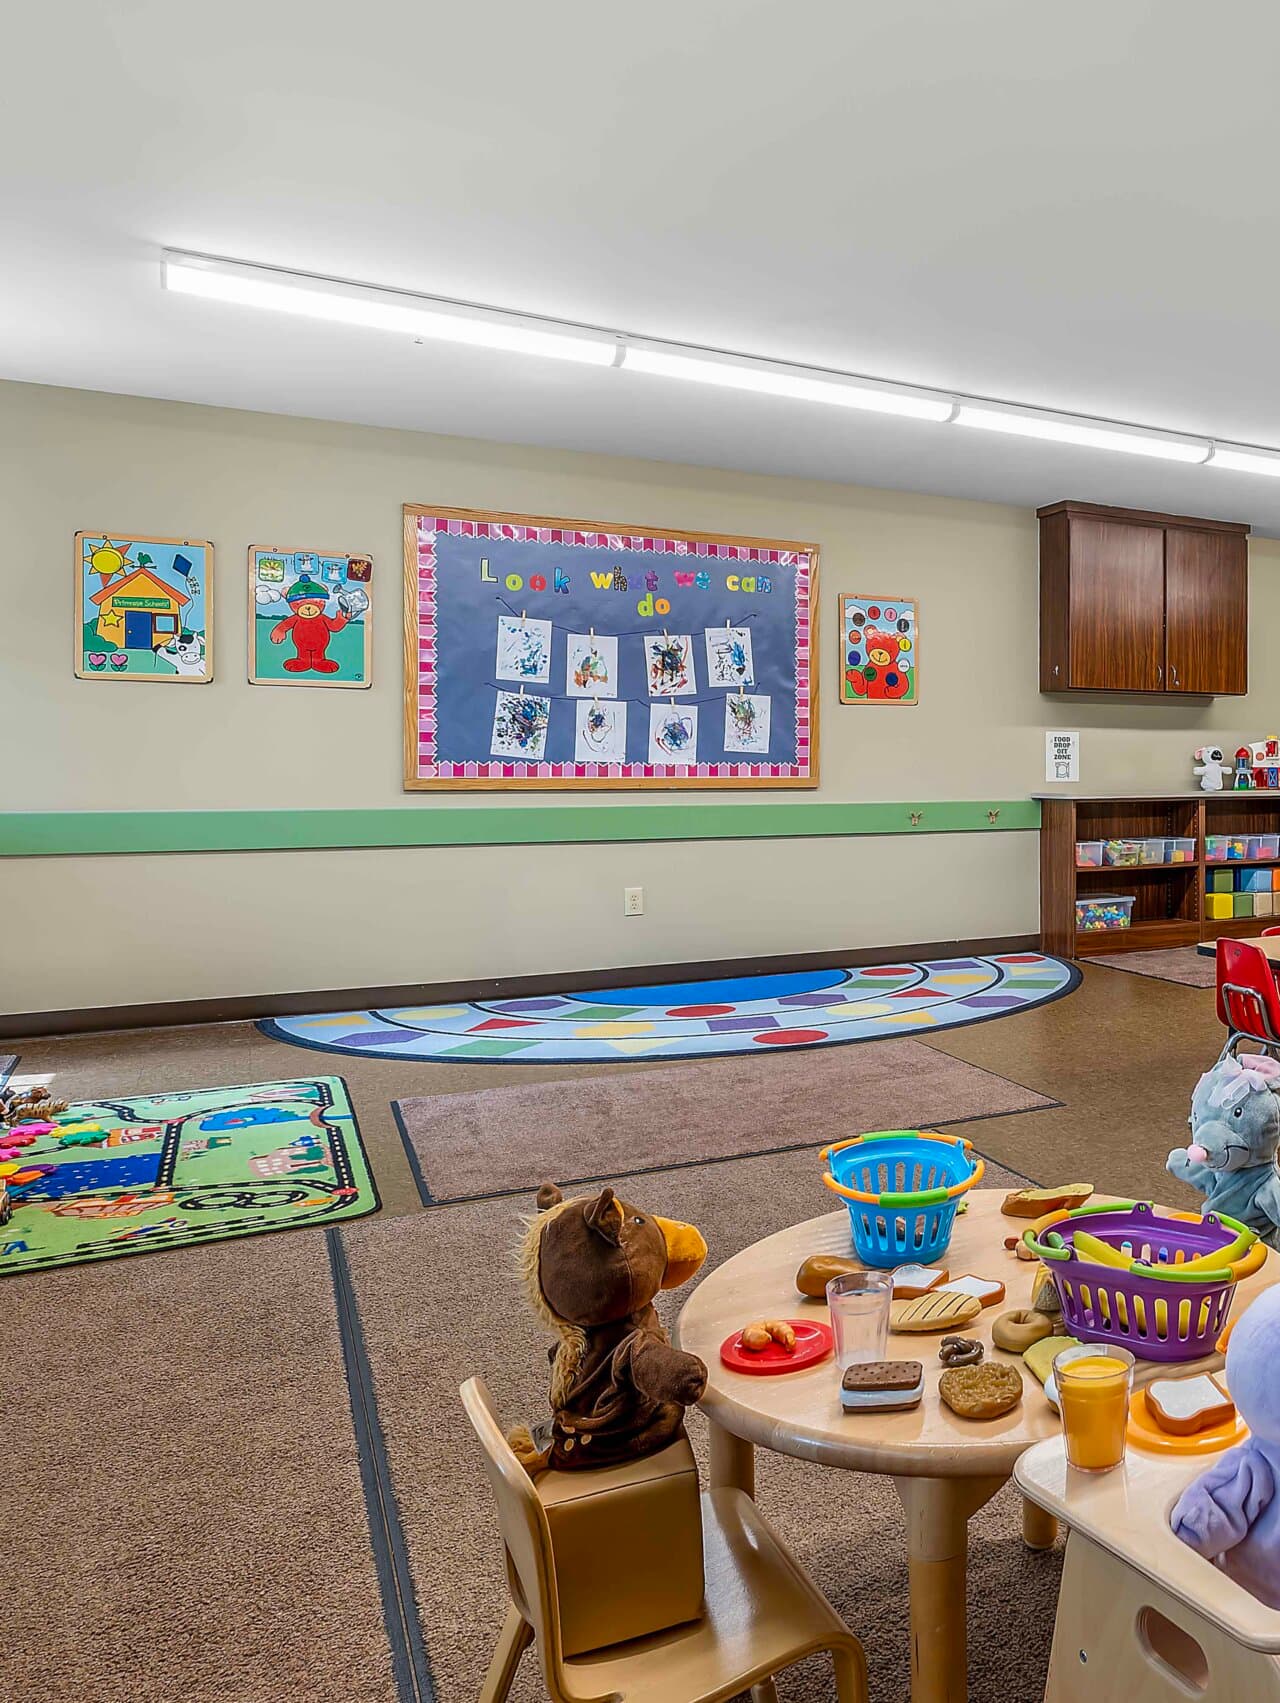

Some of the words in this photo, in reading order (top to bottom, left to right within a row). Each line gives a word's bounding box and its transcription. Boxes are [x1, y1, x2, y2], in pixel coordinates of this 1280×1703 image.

[480, 557, 571, 594] Look
[590, 566, 659, 592] what
[673, 570, 711, 590] we
[726, 574, 772, 594] can
[637, 593, 671, 617] do
